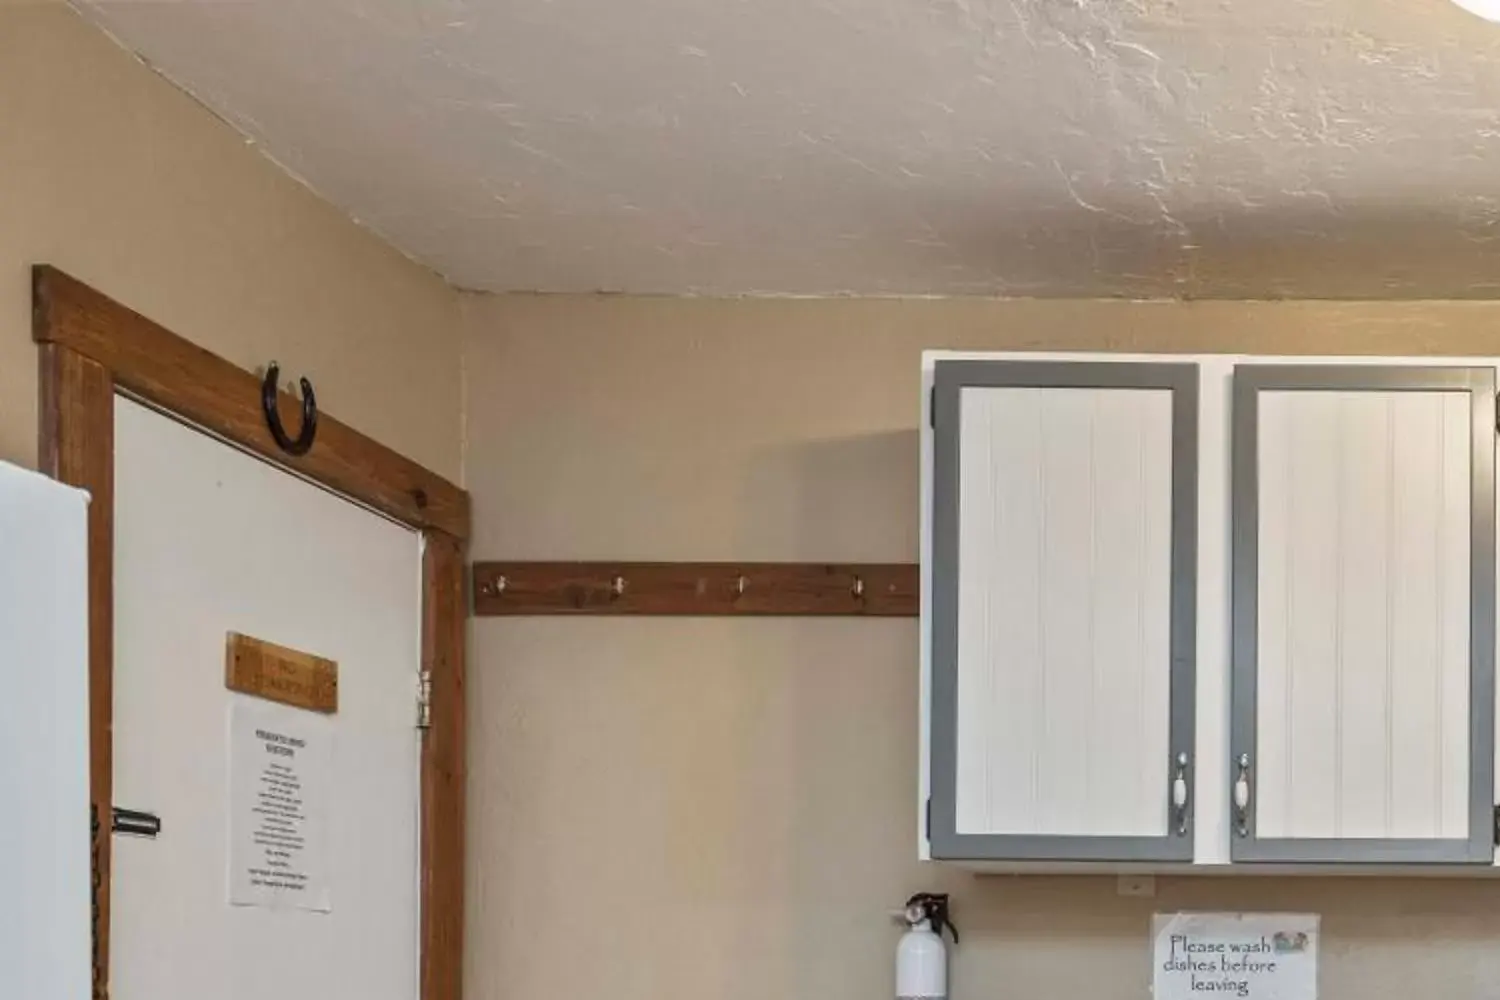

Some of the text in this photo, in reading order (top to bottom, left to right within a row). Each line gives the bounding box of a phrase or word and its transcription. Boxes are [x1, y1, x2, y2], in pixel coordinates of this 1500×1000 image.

[1169, 935, 1271, 958] Please wash
[1163, 955, 1277, 972] dishes before
[1191, 974, 1249, 996] leaving
